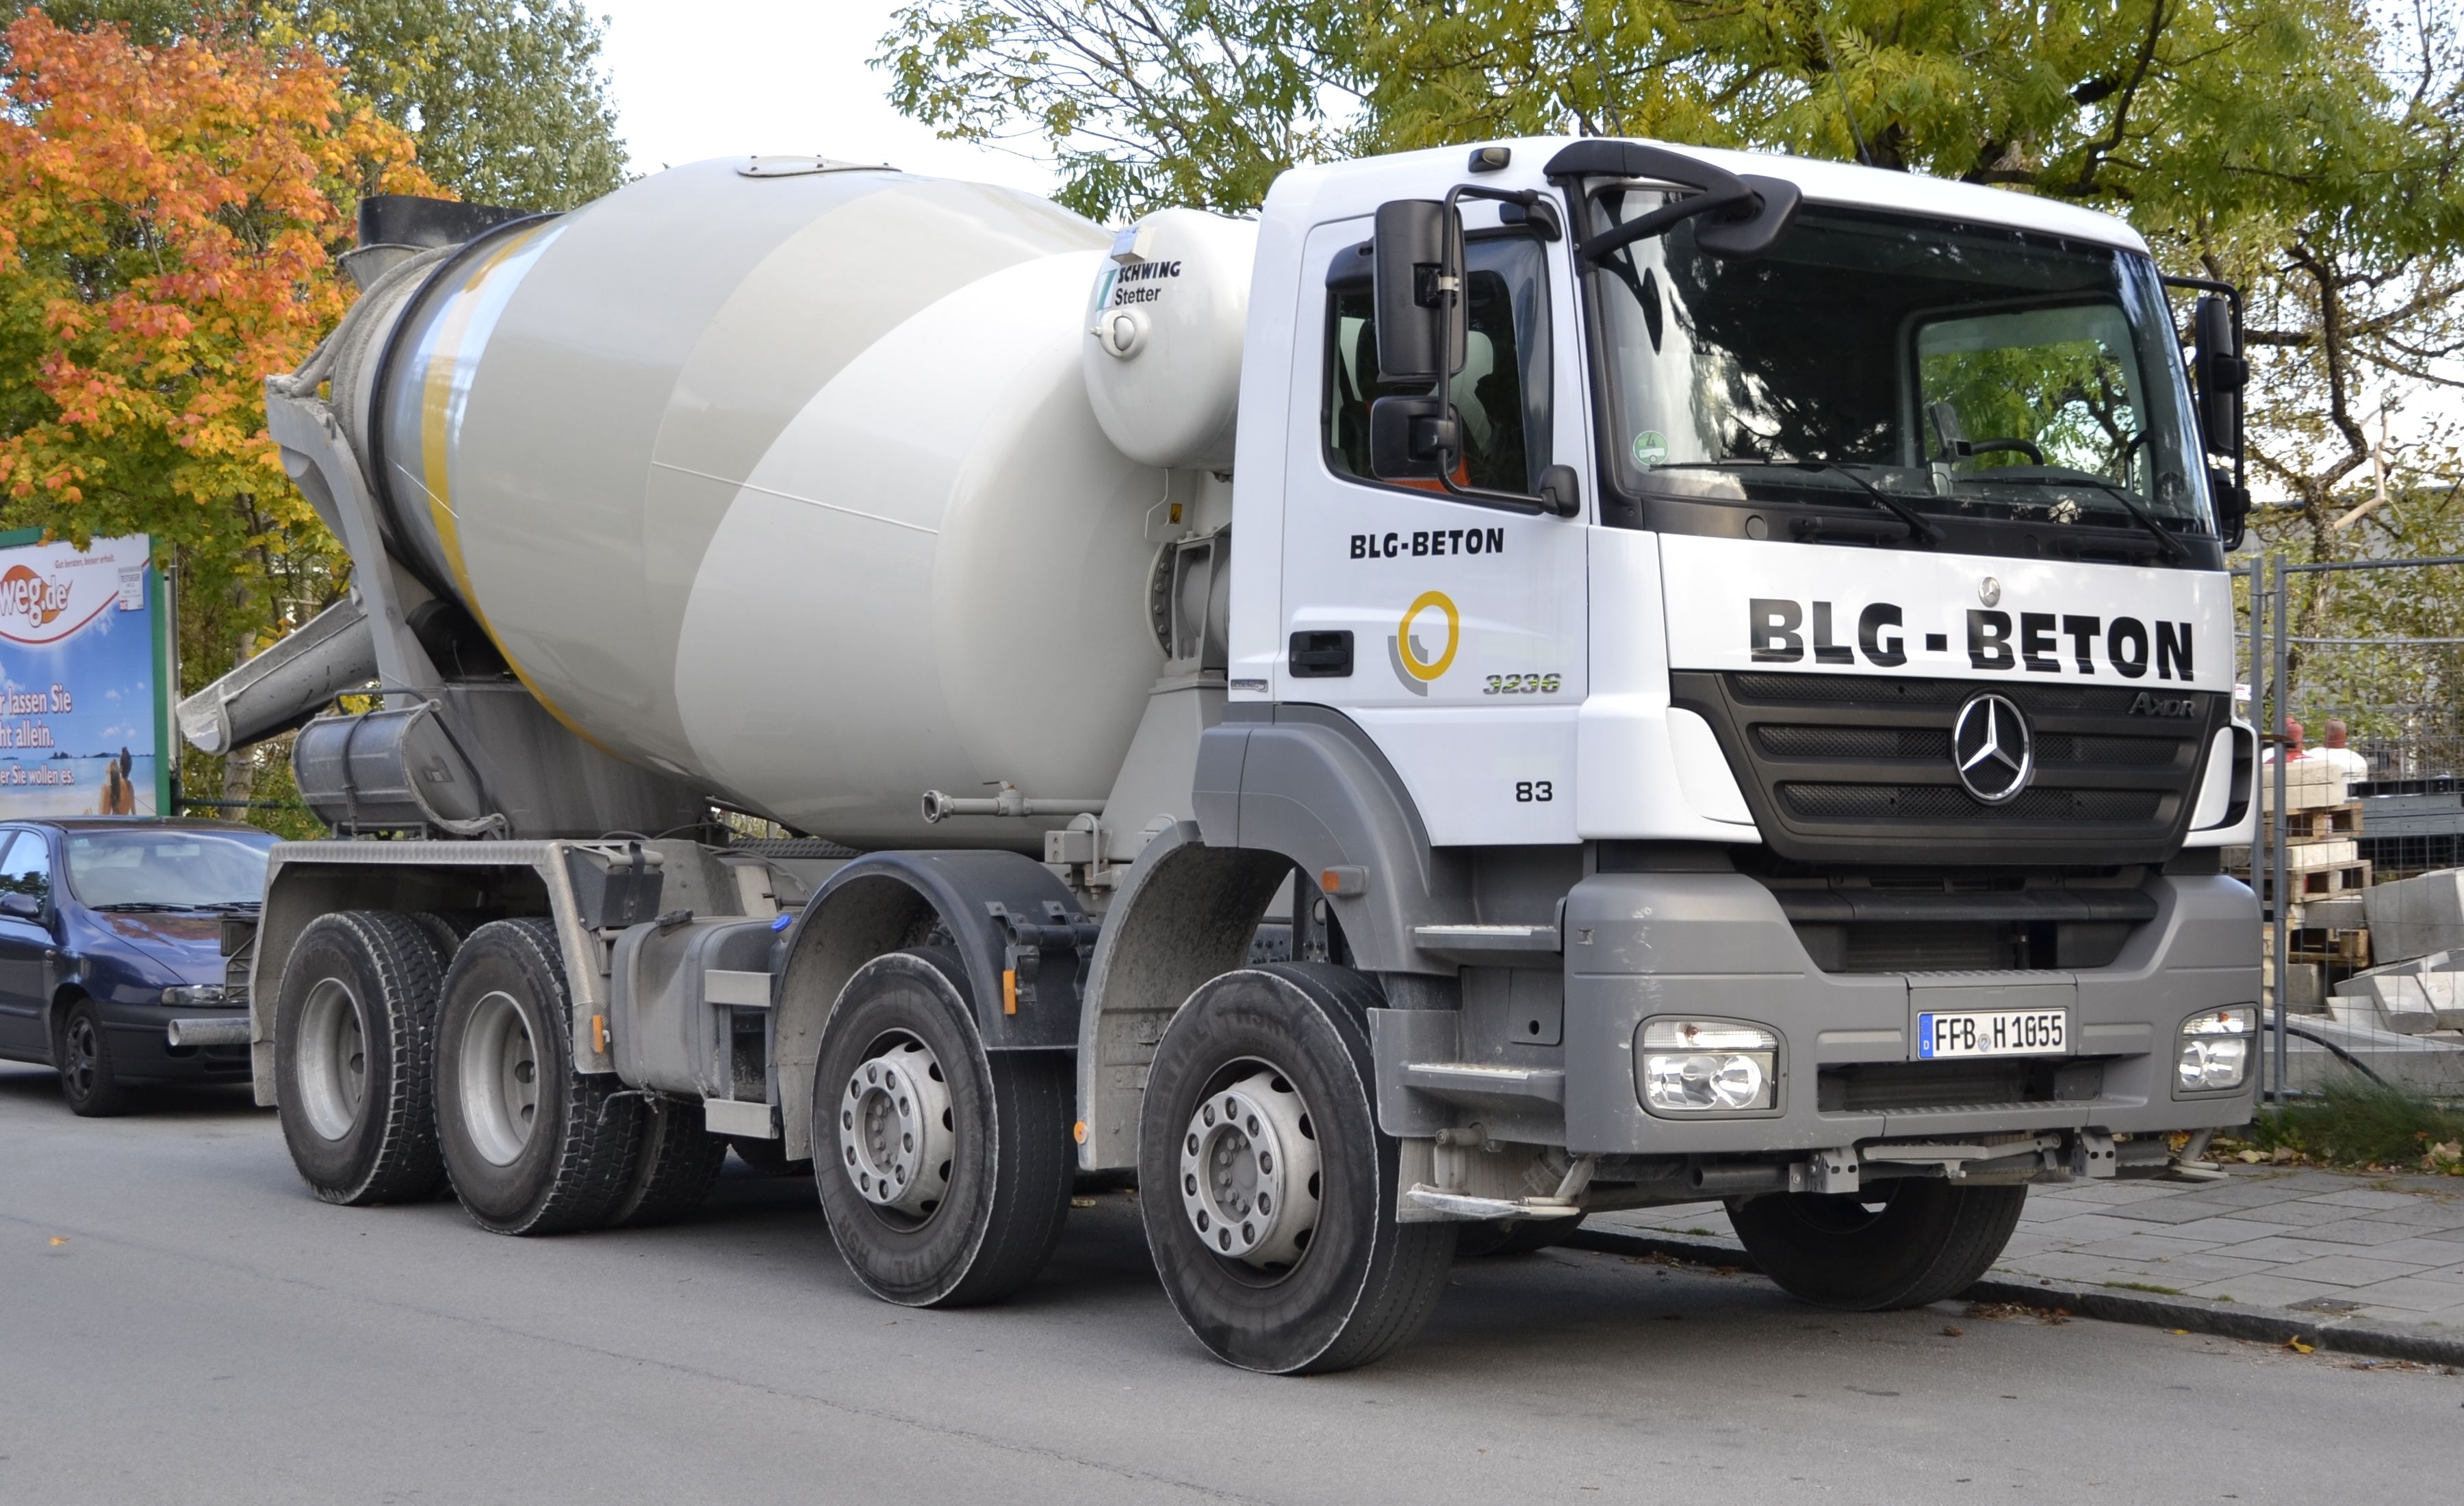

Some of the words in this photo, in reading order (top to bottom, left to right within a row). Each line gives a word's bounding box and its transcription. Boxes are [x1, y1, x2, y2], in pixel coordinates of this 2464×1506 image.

[1118, 261, 1182, 284] SCHWING
[1115, 287, 1162, 306] Stetter
[1646, 433, 1656, 448] 4
[1350, 527, 1504, 559] BLG-BETON
[1482, 673, 1562, 695] 3236
[8, 686, 47, 715] lassen
[51, 683, 72, 713] Sie
[16, 719, 55, 748] allein.
[12, 763, 27, 785] Sie
[29, 763, 59, 785] wollen
[62, 768, 75, 785] es.
[1515, 780, 1554, 803] 83
[1923, 1041, 1929, 1050] D
[1935, 1018, 1977, 1051] FFB
[1993, 1017, 2006, 1049] H
